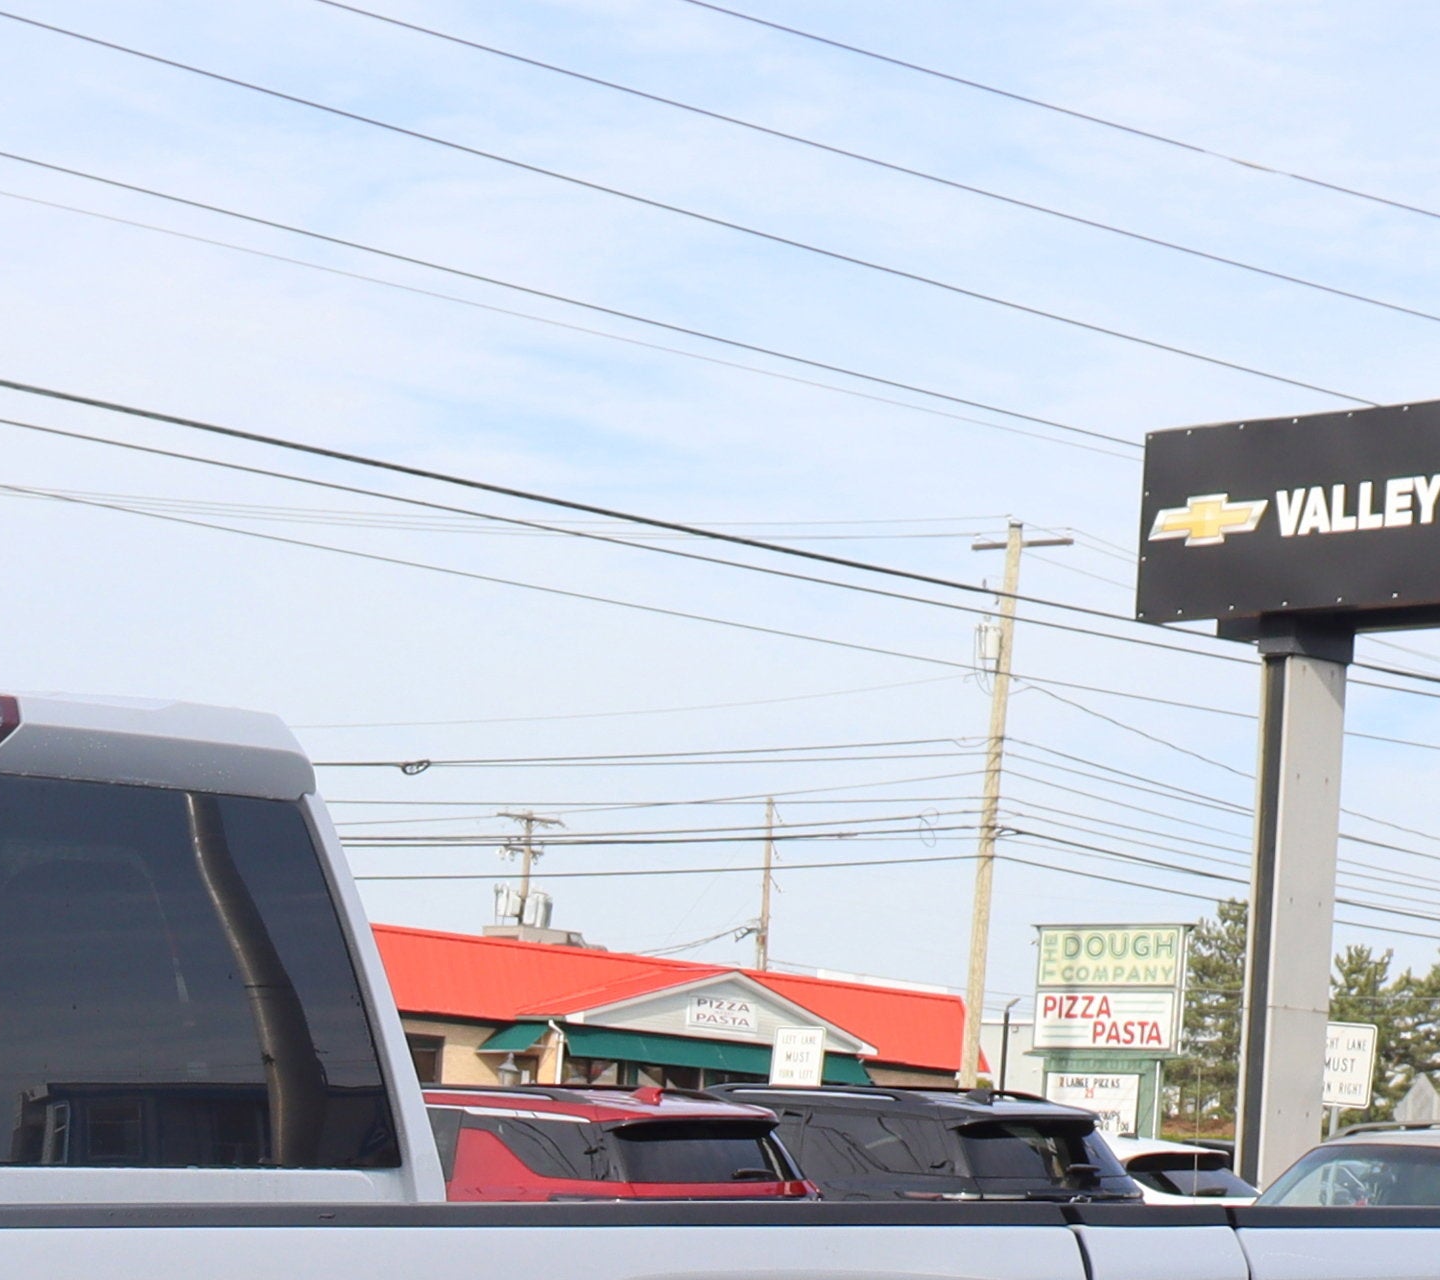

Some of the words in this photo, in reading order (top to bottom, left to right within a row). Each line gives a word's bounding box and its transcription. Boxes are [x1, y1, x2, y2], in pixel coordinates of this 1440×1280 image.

[1062, 932, 1177, 960] DOUGH
[1042, 933, 1058, 982] THE
[1061, 966, 1175, 982] COMPANY
[697, 998, 750, 1013] PIZZA
[1043, 995, 1111, 1019] PIZZA
[696, 1012, 749, 1027] PASTA
[1092, 1021, 1162, 1045] PASTA
[1346, 1038, 1368, 1051] LANE
[785, 1051, 810, 1063] MUST
[1339, 1082, 1362, 1096] RIGHT
